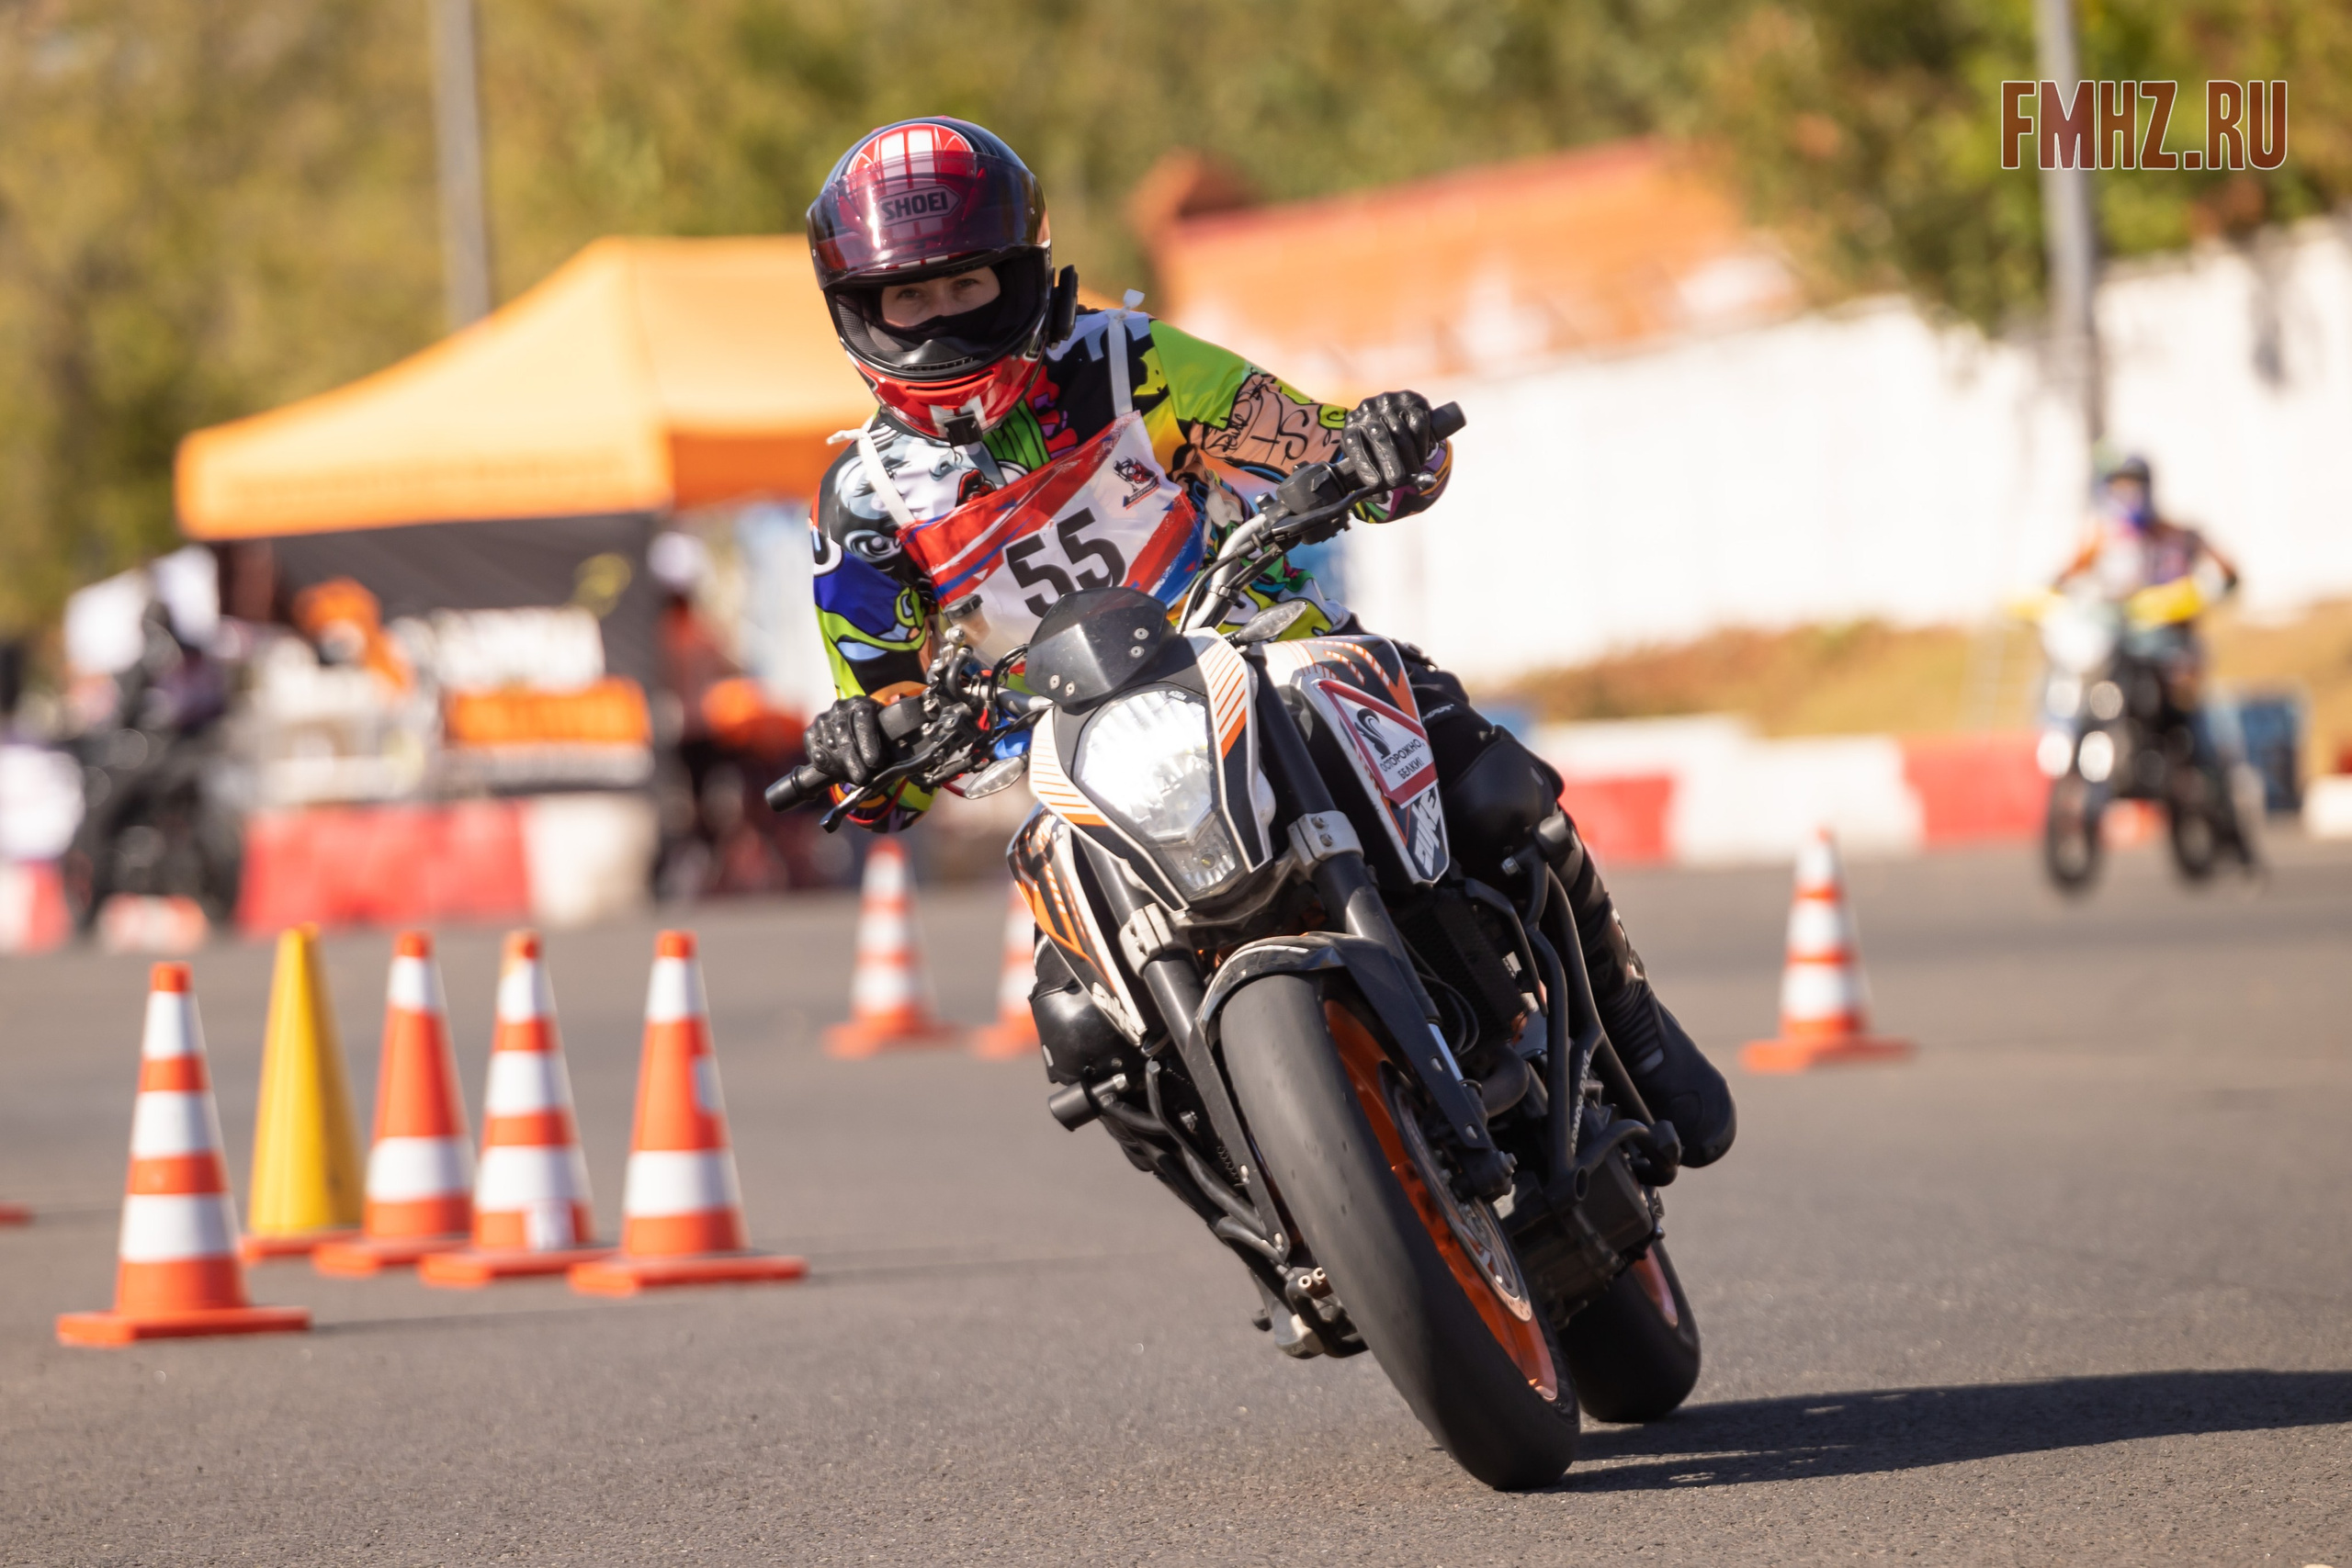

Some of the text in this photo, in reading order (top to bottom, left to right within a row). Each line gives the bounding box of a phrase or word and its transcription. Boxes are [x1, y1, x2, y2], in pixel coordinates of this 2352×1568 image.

[882, 190, 949, 221] SHOEI
[1006, 507, 1126, 618] 55
[1380, 739, 1426, 773] ОСТОРОЖНО,
[1397, 757, 1424, 780] БЕЛКИ!
